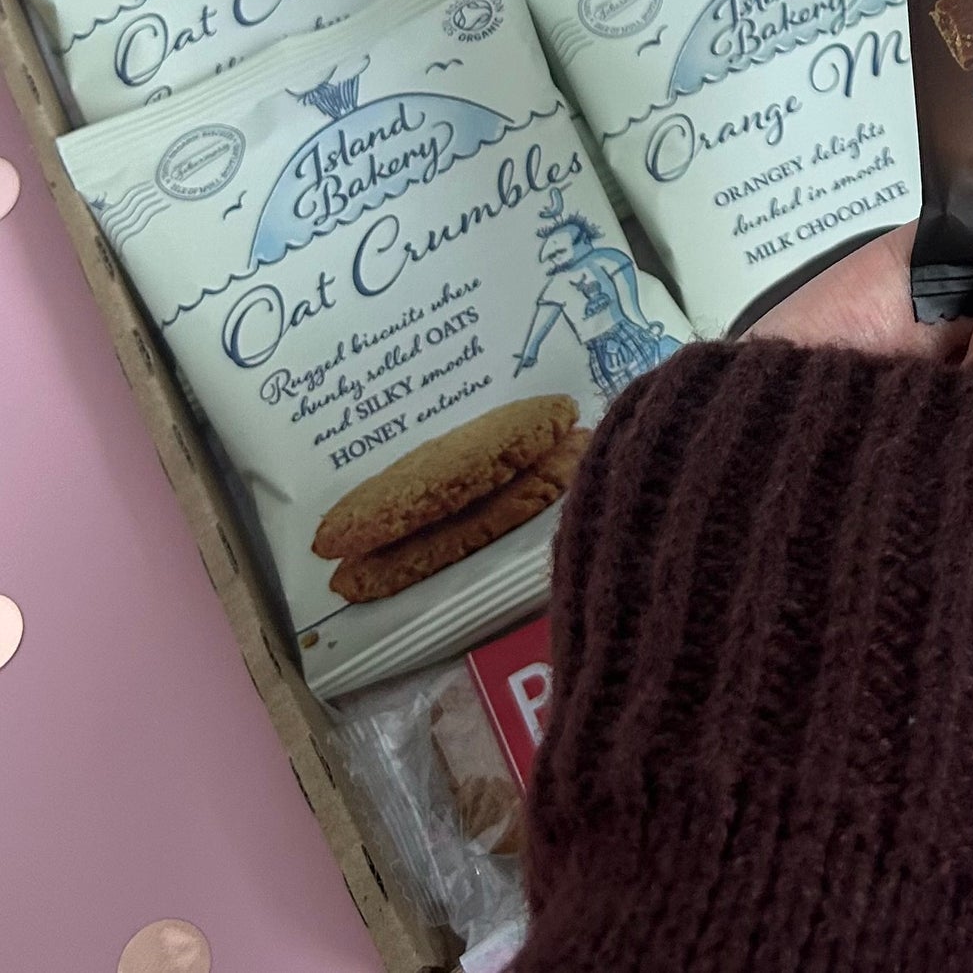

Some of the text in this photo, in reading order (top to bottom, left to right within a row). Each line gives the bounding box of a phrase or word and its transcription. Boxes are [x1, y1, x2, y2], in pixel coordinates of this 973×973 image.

[114, 5, 219, 87] Oat
[458, 16, 505, 43] ORGANIC
[293, 121, 454, 225] Bakery
[295, 104, 426, 185] Island
[645, 94, 802, 183] Orange
[713, 122, 886, 208] ORANGEY delights
[733, 146, 896, 237] dunked in smooth
[743, 180, 910, 266] MILK CHOCOLATE
[221, 144, 584, 369] Oat Crumbles
[260, 275, 482, 406] Rugged biscuits where
[291, 306, 480, 424] chunky rolled OATS
[314, 336, 485, 447] and SILKY smooth
[328, 373, 494, 471] HONEY entwine
